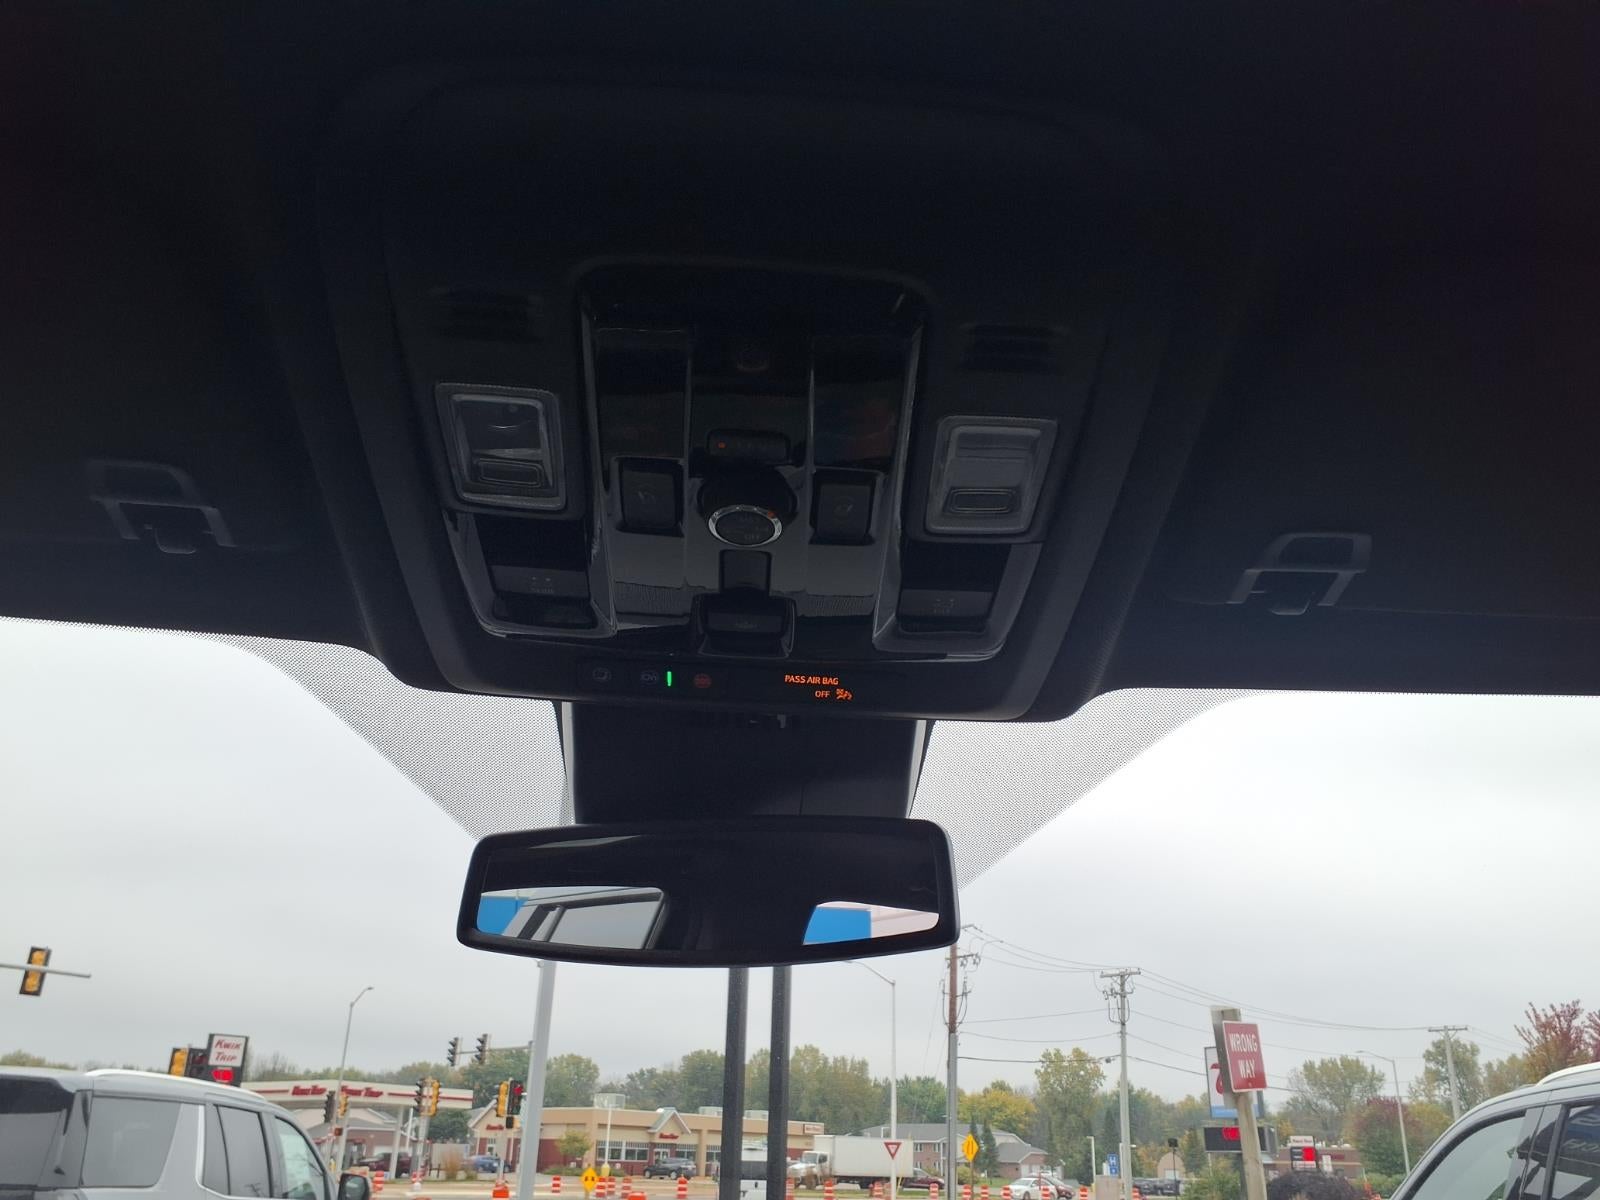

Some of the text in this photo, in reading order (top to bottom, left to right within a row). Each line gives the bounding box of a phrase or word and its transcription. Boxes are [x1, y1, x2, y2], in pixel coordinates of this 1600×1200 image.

[784, 675, 839, 685] PASS AIR BAG
[814, 690, 831, 698] OFF
[1229, 1033, 1258, 1053] WRONG
[1238, 1059, 1256, 1078] WAY
